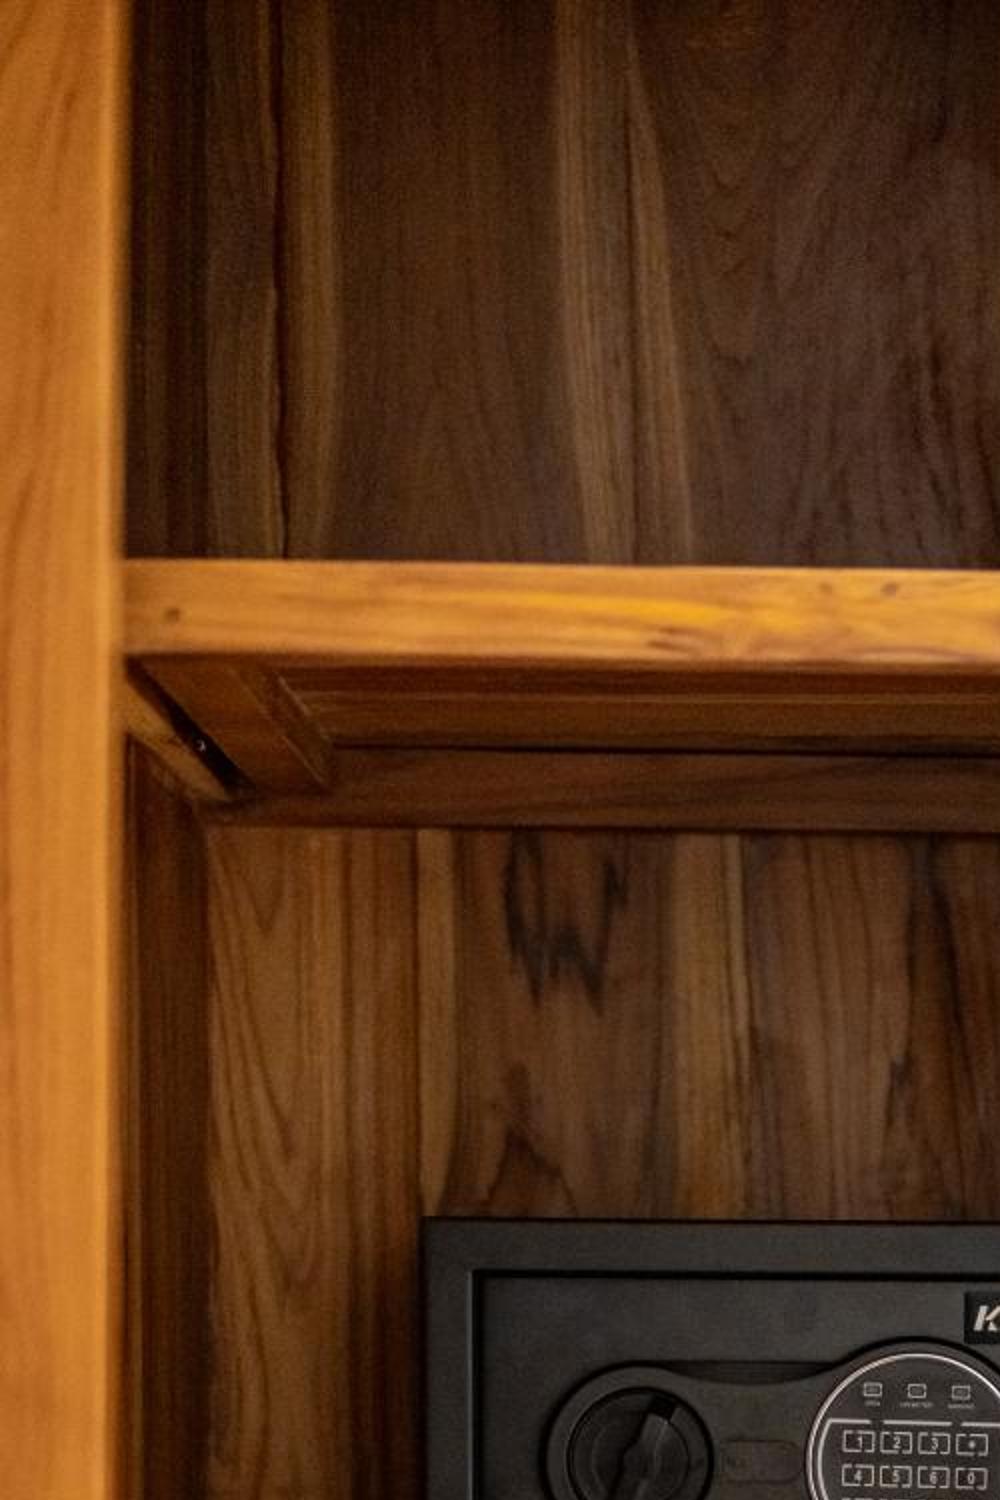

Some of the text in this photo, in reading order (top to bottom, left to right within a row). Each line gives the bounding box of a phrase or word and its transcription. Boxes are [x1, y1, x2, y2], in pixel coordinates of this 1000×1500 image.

[857, 1436, 939, 1450] 1 2 3
[853, 1470, 975, 1484] 4 5 6 0
